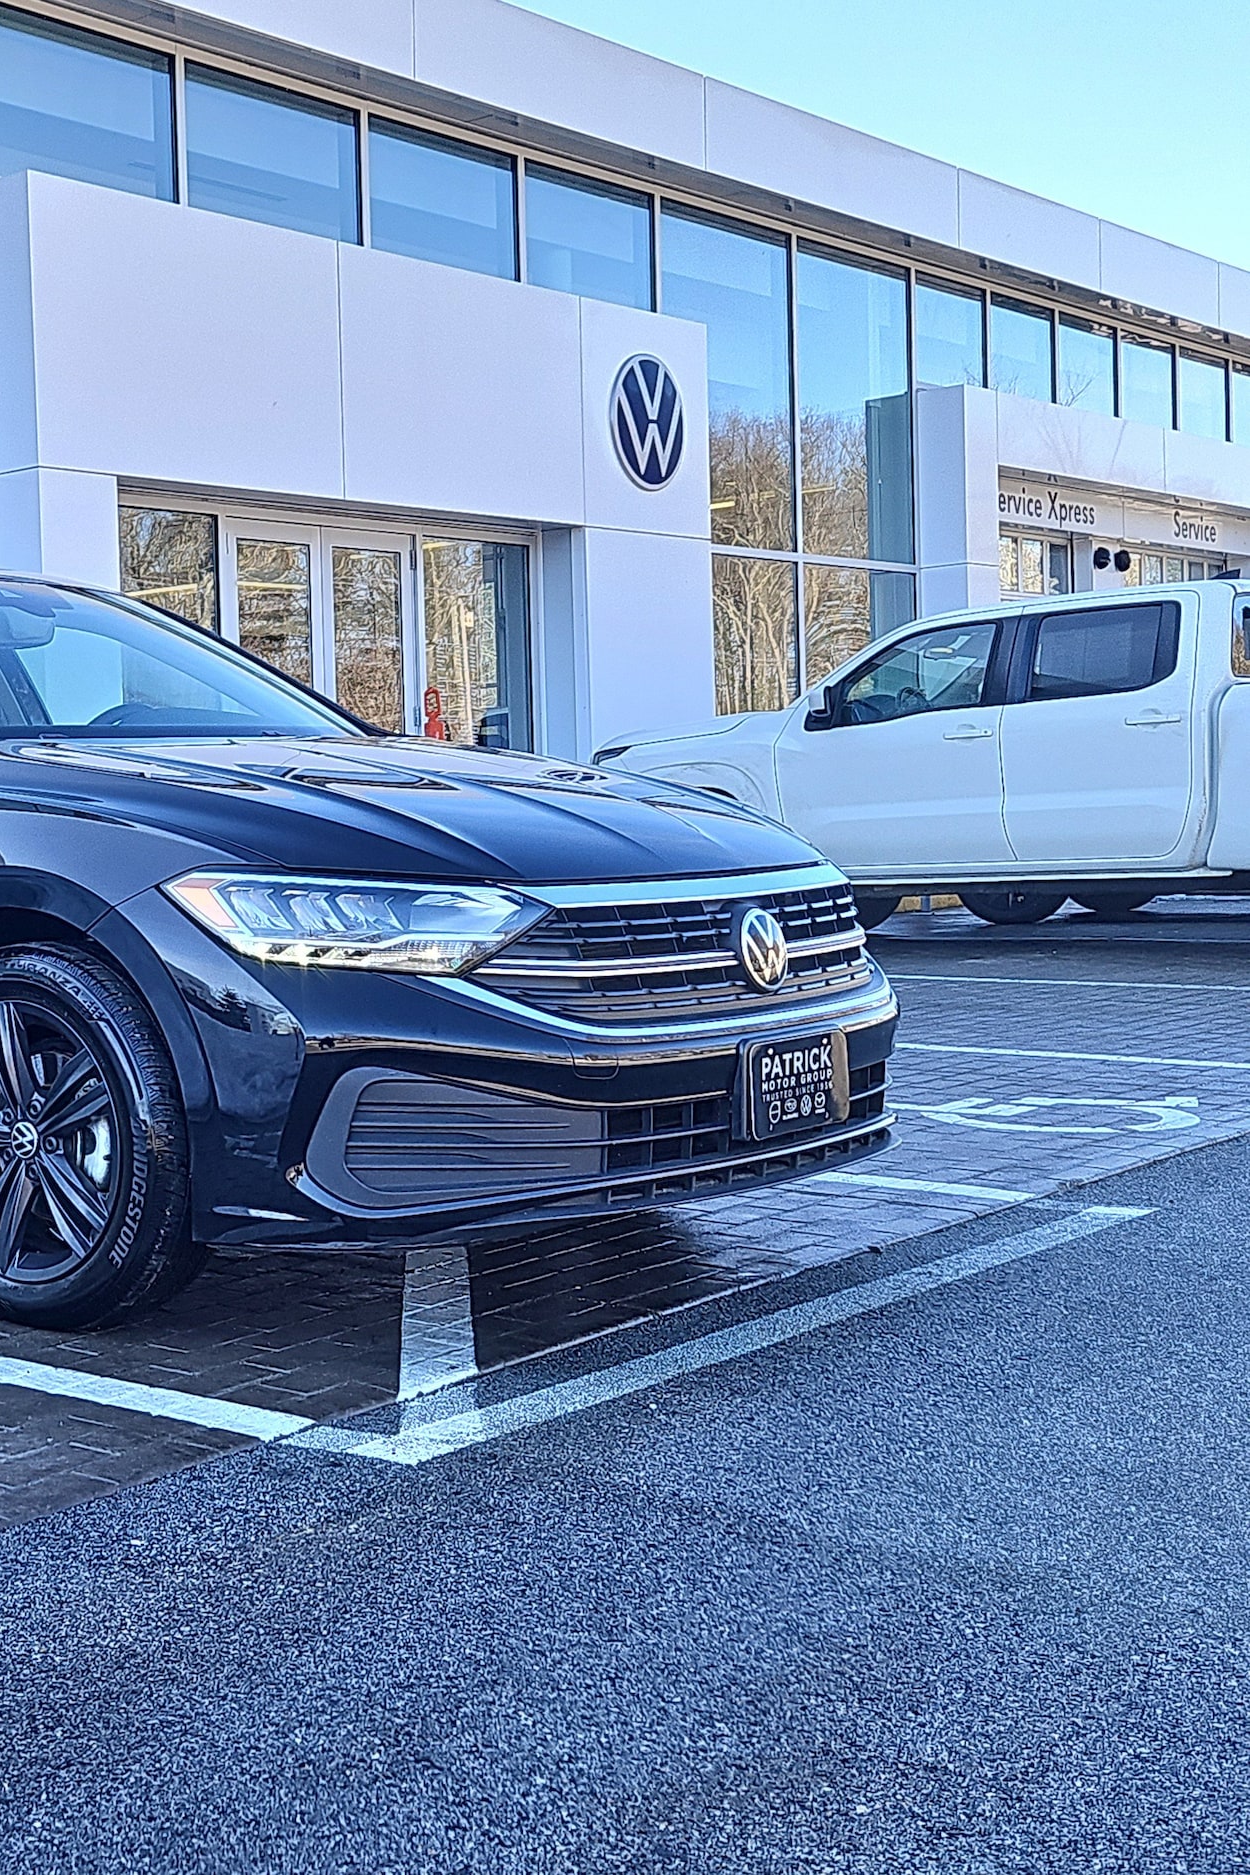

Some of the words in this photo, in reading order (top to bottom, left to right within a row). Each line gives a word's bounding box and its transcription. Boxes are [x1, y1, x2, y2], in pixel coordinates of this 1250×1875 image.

[999, 487, 1042, 518] ervice
[1047, 491, 1095, 528] Xpress
[1173, 510, 1216, 543] Service
[4, 959, 82, 997] TURANZA
[761, 1044, 832, 1081] PATRICK
[761, 1076, 796, 1093] MOTOR
[800, 1068, 833, 1085] GROUP
[762, 1090, 793, 1103] TRUSTED
[795, 1083, 815, 1097] SINCE
[109, 1116, 149, 1269] BRIDGESTONE
